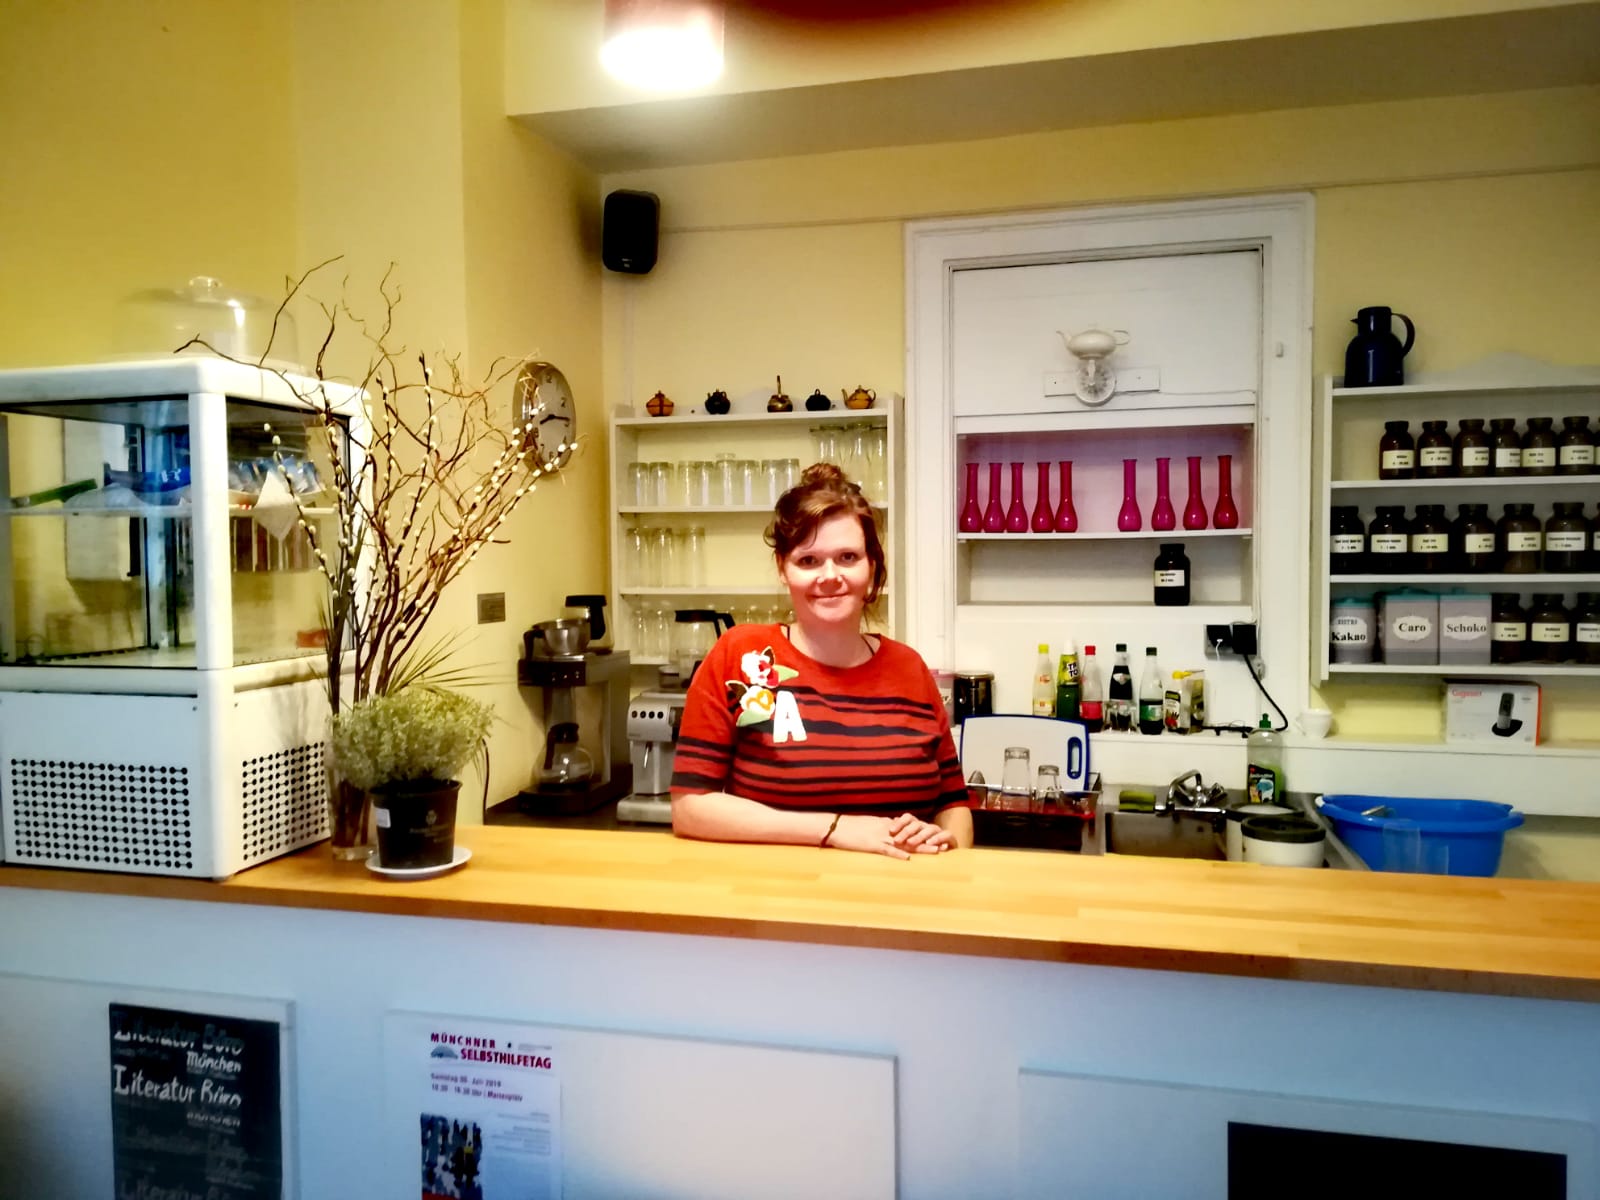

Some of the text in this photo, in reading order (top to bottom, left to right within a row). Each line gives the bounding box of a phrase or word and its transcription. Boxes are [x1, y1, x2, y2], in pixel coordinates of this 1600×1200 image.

[1398, 623, 1426, 632] Caro
[1446, 623, 1487, 633] Schoko
[1331, 631, 1366, 642] Kakao
[773, 690, 807, 743] A
[430, 1032, 496, 1048] MÜNCHNER
[460, 1048, 552, 1069] SELBSTHILFETAG
[113, 1064, 197, 1103] Literatur
